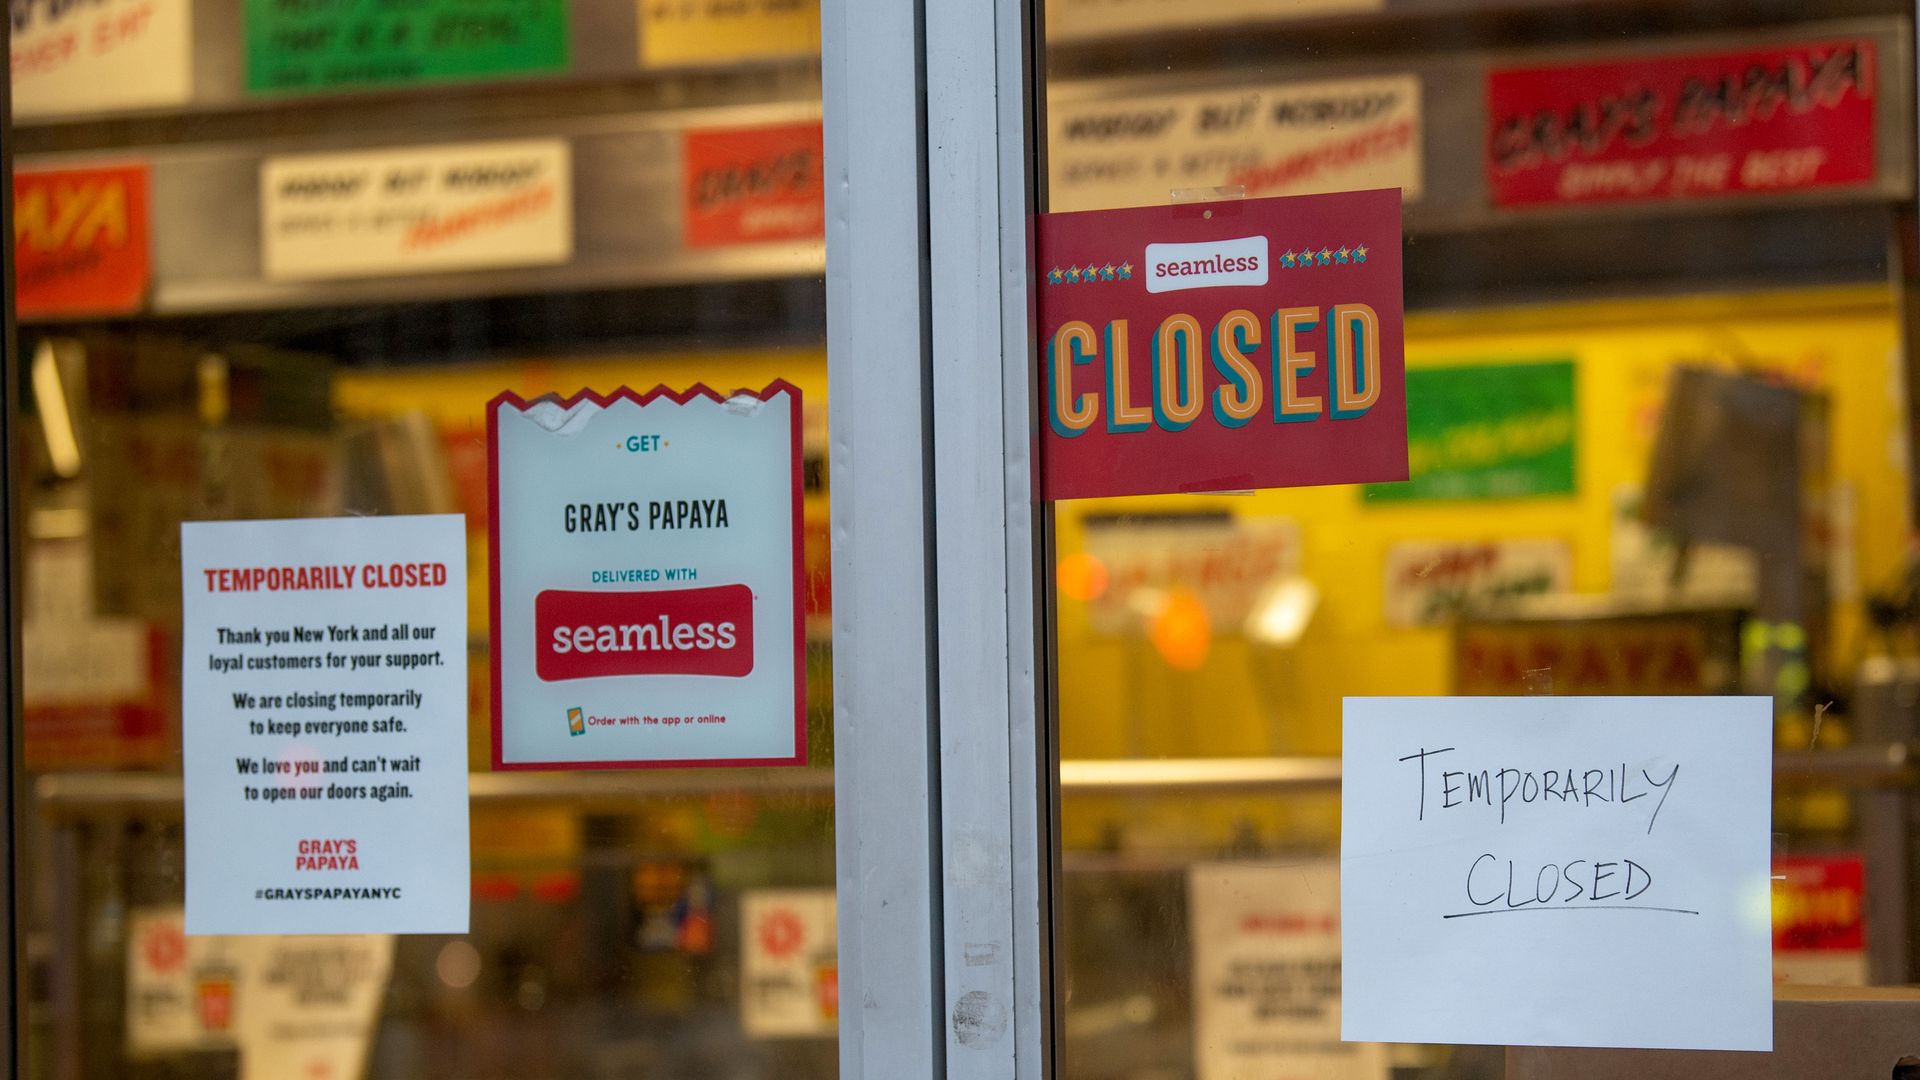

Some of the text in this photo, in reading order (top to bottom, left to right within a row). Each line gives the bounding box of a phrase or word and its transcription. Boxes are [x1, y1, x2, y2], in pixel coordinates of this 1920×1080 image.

[1155, 253, 1259, 278] seamless
[1048, 303, 1381, 439] CLOSED
[626, 434, 660, 453] GET
[564, 498, 729, 534] GRAY'S PAPAYA
[203, 560, 447, 593] TEMPORARILY CLOSED
[591, 567, 697, 584] DELIVERED WITH
[216, 623, 436, 647] Thank you New York and all our
[552, 614, 737, 655] seamless
[208, 650, 444, 672] loyal customers for your support.
[232, 689, 423, 712] We are closing temporarily
[249, 716, 407, 738] to keep everyone safe.
[587, 713, 726, 728] Order with the app or online
[235, 755, 421, 777] We love you and can't wait
[243, 781, 413, 804] to open our doors again.
[1399, 747, 1680, 835] TEMPORARILY
[298, 839, 357, 855] GRAY'S
[296, 855, 359, 872] PAPAYA
[1466, 852, 1652, 908] CLOSED
[255, 887, 401, 901] #GRAYSPAPAYANYC
